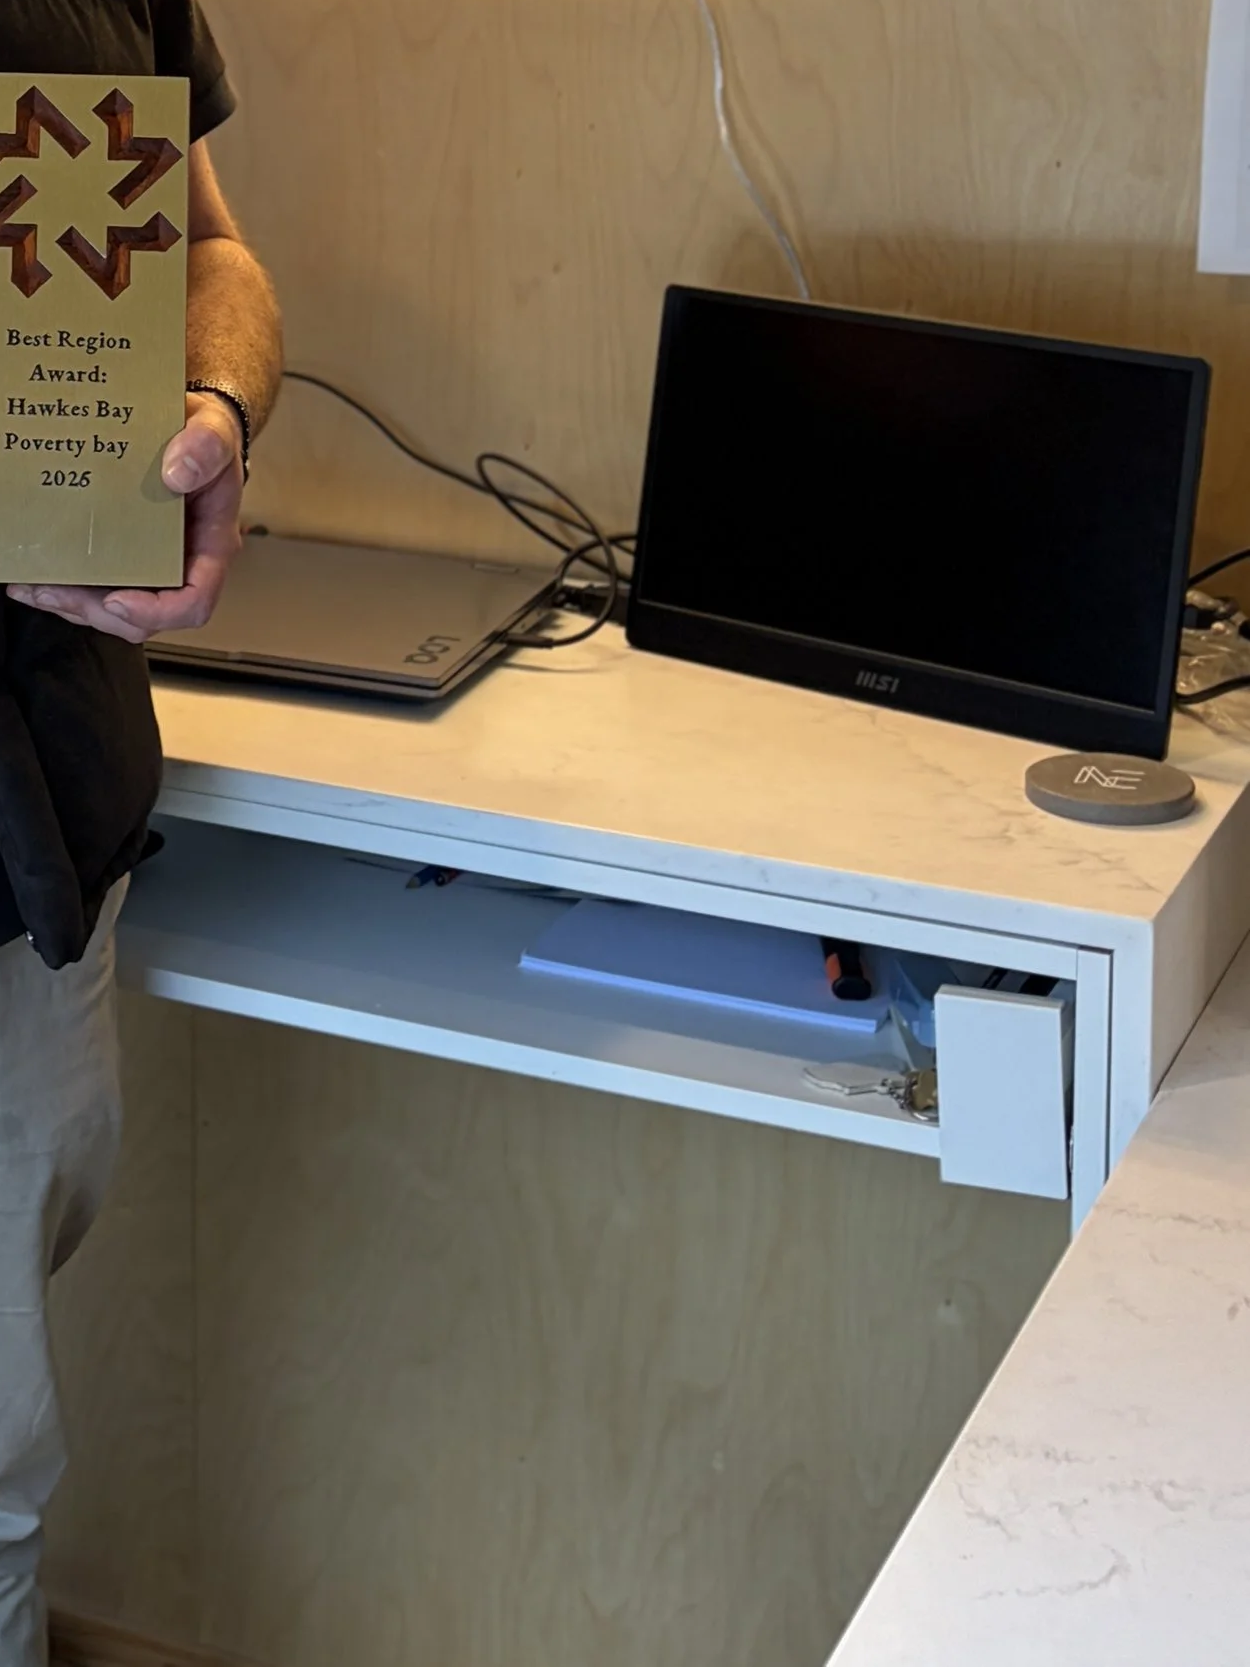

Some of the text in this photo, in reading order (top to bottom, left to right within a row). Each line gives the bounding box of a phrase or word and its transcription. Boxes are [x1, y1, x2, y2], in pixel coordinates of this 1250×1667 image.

[6, 329, 131, 355] Best Region
[28, 364, 107, 383] Award:
[7, 397, 134, 424] Hawkes Bay
[4, 432, 129, 459] Poverty bay
